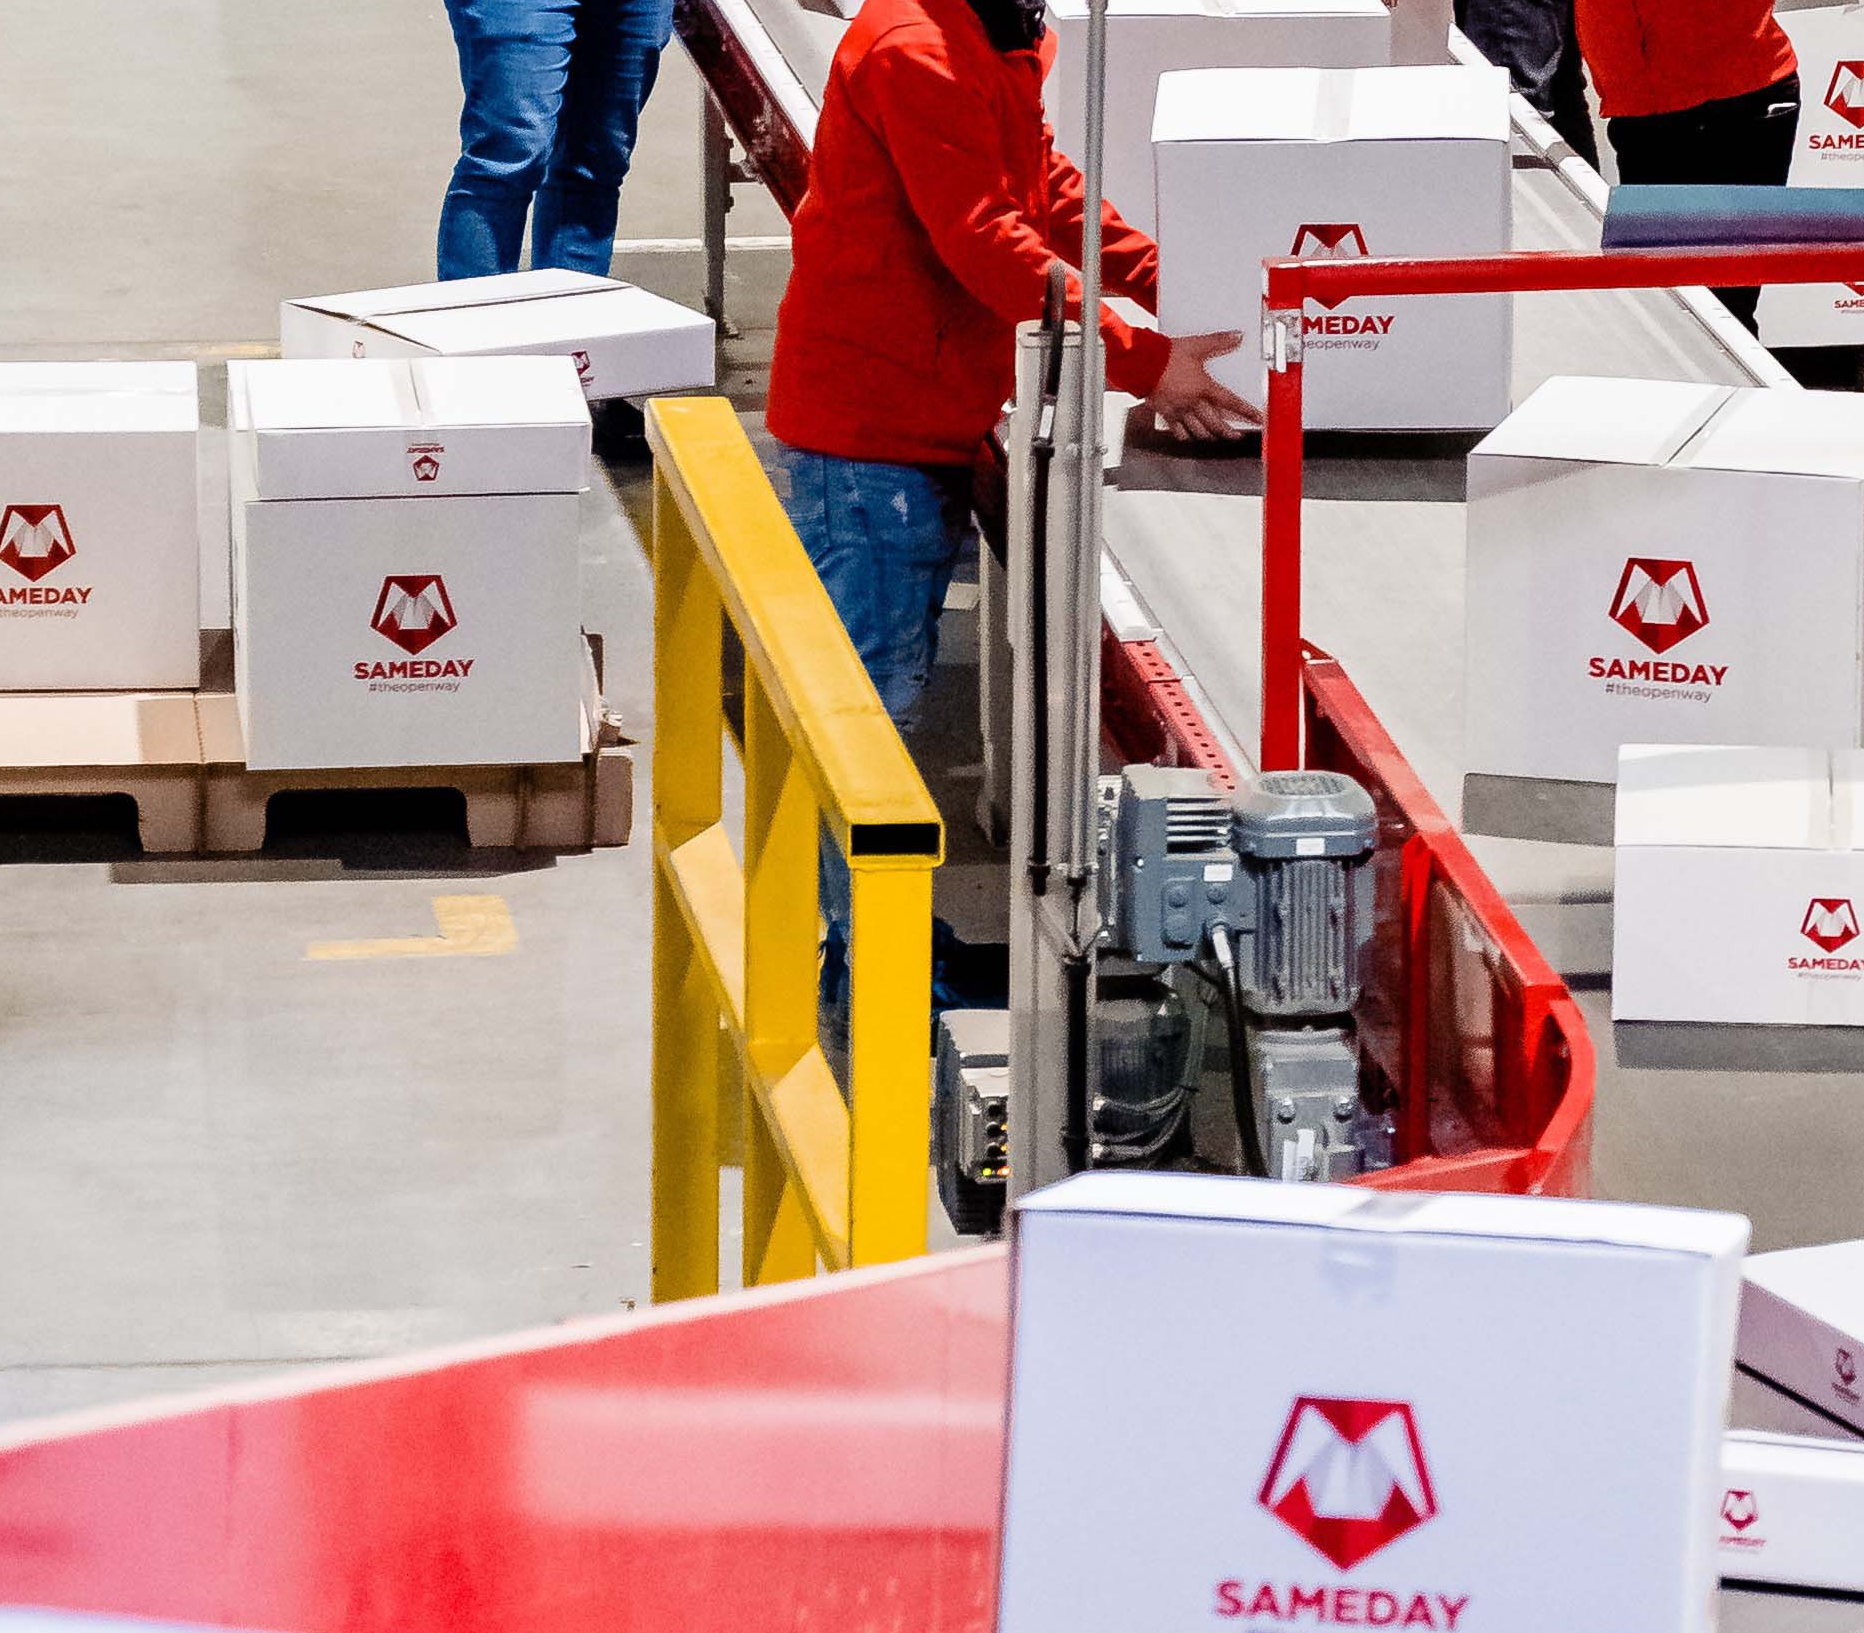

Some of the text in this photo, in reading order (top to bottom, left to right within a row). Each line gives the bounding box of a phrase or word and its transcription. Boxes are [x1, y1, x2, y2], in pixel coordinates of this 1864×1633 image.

[1302, 315, 1395, 336] MEDAY
[1302, 338, 1381, 352] eopenway
[354, 659, 475, 680] SAMEDAY
[1588, 657, 1729, 687] SAMEDAY
[369, 681, 461, 693] #theopenway
[1605, 682, 1713, 704] #theopenway
[1215, 1579, 1471, 1633] SAMEDAY
